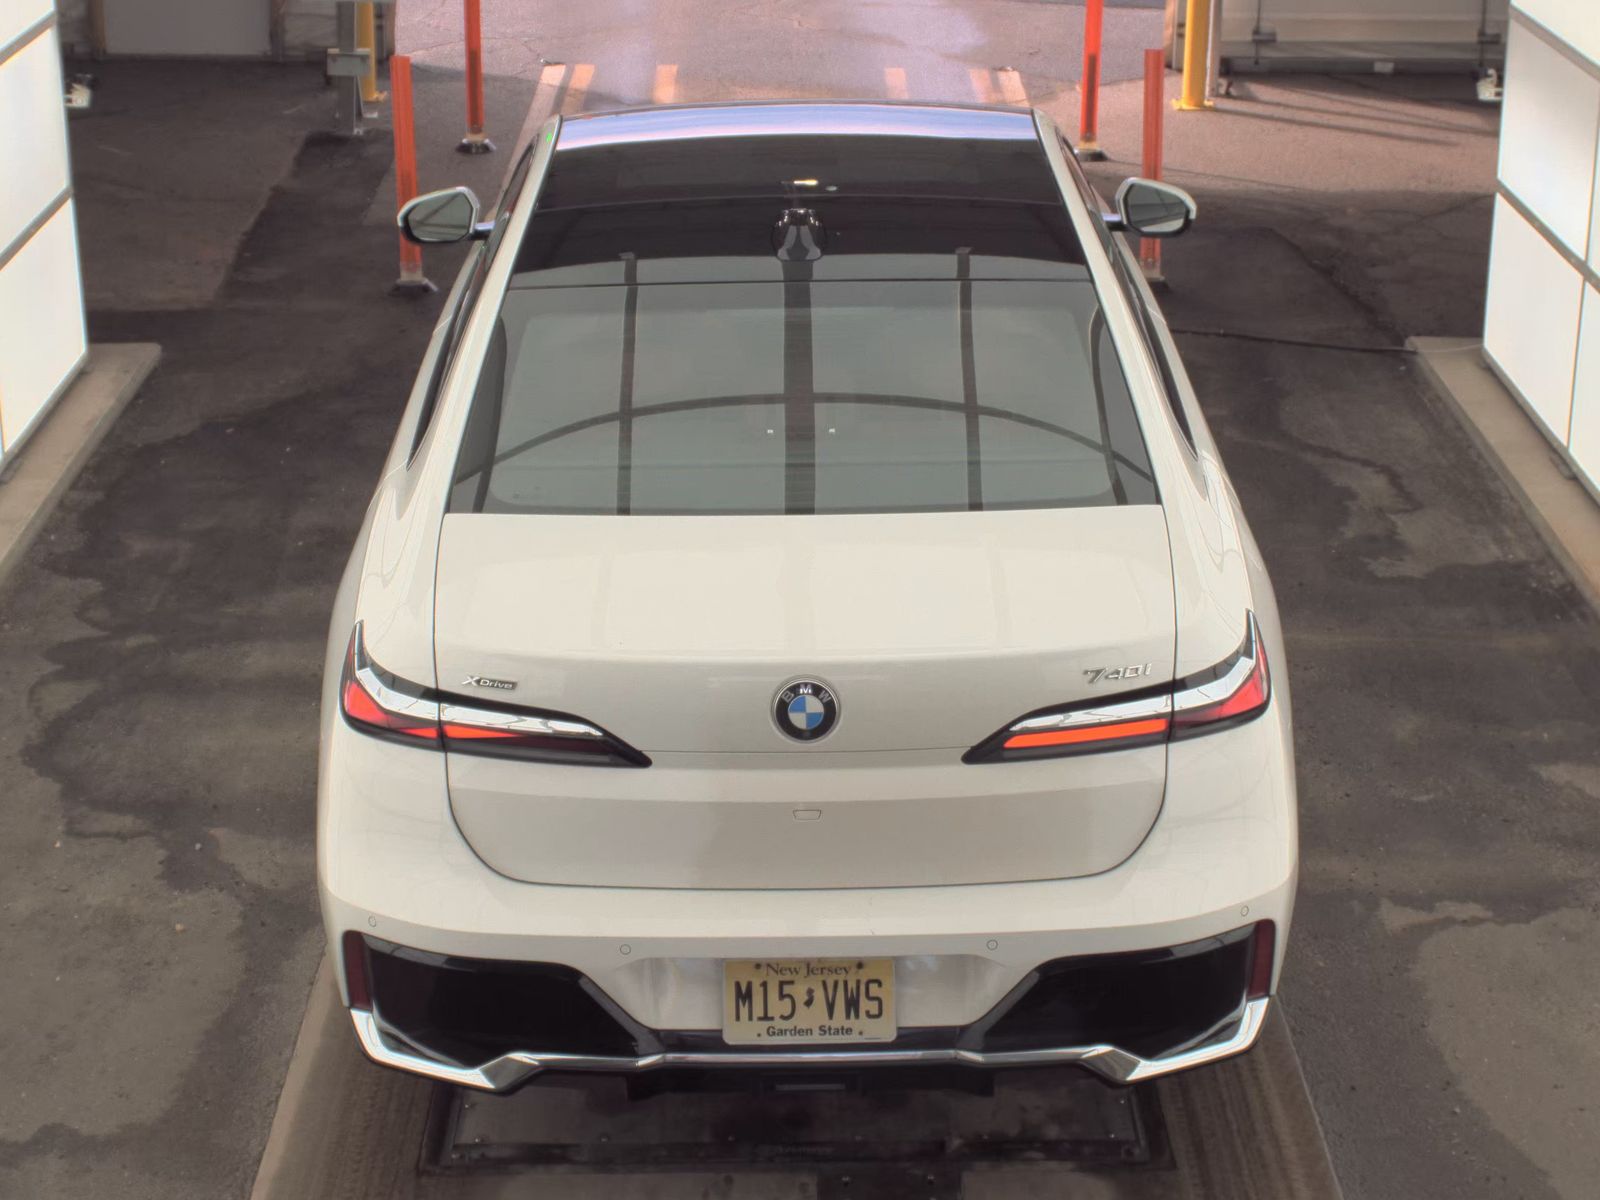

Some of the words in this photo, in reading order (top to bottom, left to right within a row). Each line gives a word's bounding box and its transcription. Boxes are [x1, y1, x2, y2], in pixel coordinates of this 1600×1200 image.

[780, 684, 832, 704] BMW
[766, 963, 800, 976] New
[804, 962, 852, 978] Jersey
[734, 980, 797, 1022] M15
[822, 979, 883, 1020] VWS
[766, 1026, 813, 1037] Garden
[818, 1025, 853, 1036] State
